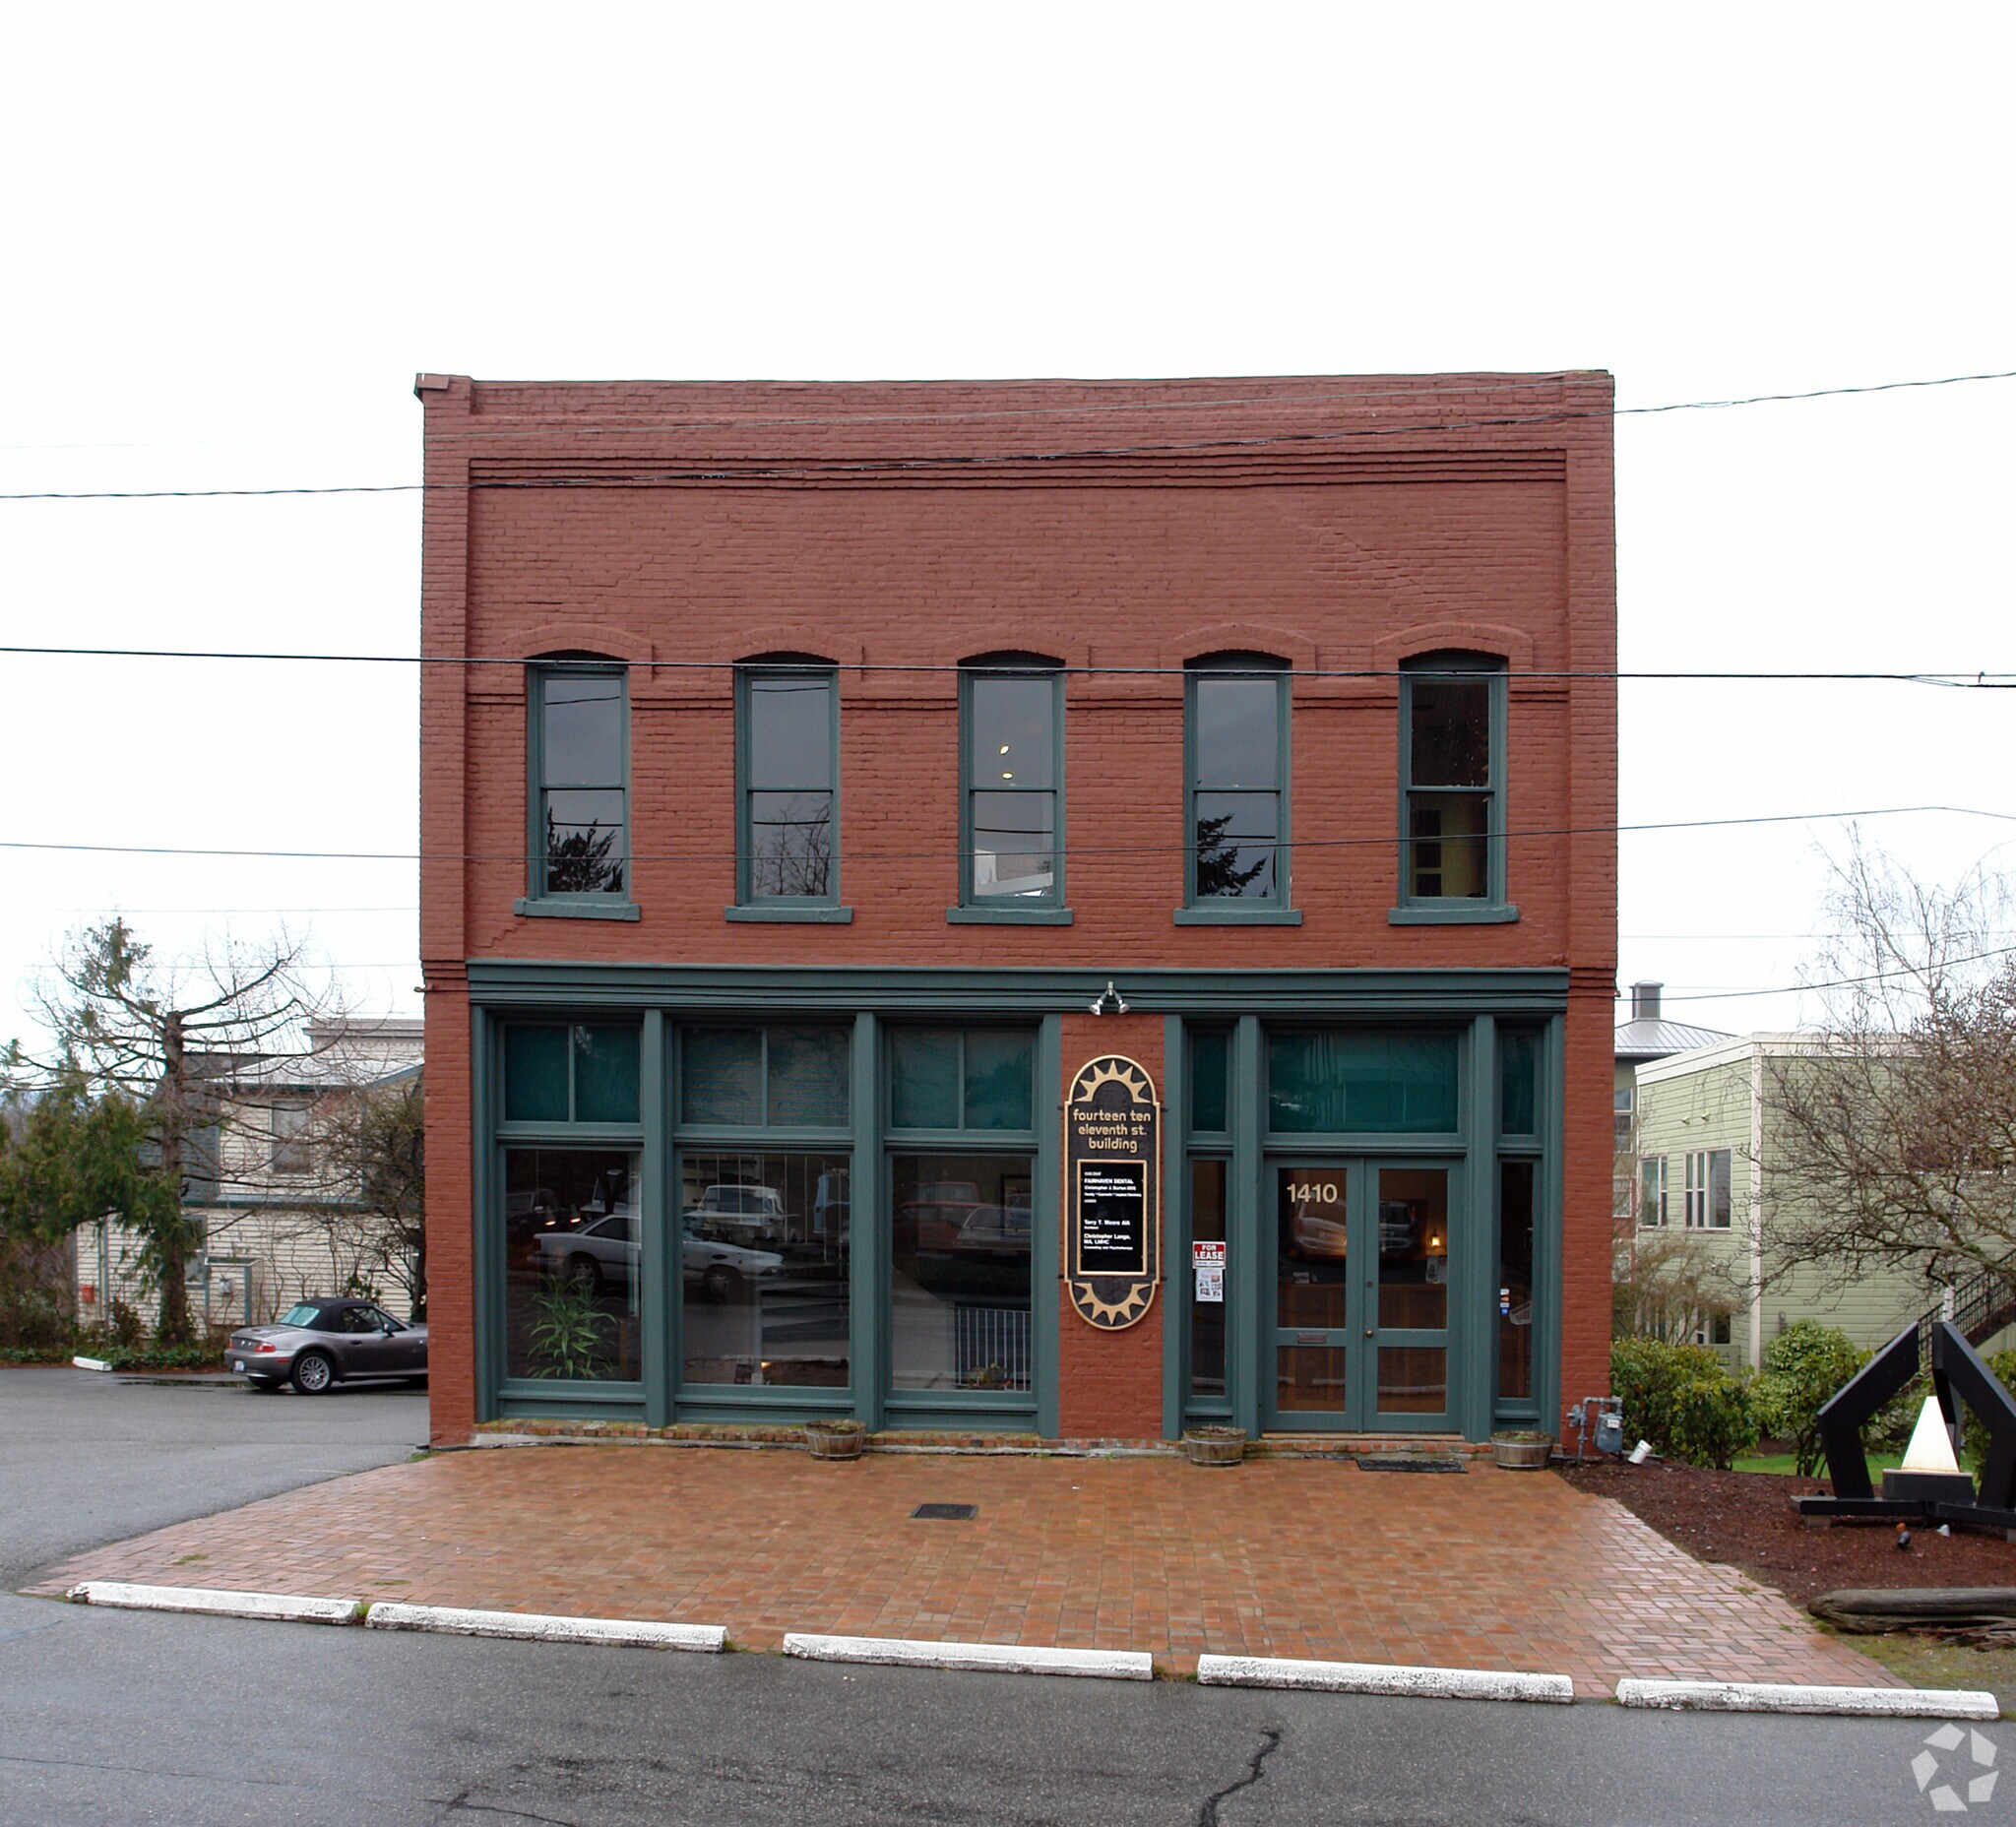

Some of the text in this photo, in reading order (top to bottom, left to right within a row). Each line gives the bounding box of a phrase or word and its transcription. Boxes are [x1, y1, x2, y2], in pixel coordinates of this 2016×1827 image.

[1073, 1108, 1151, 1121] fourteen ten
[1078, 1123, 1147, 1135] eleventh st.
[1089, 1137, 1138, 1154] building
[1287, 1183, 1338, 1203] 1410
[1195, 1251, 1224, 1260] LEASE
